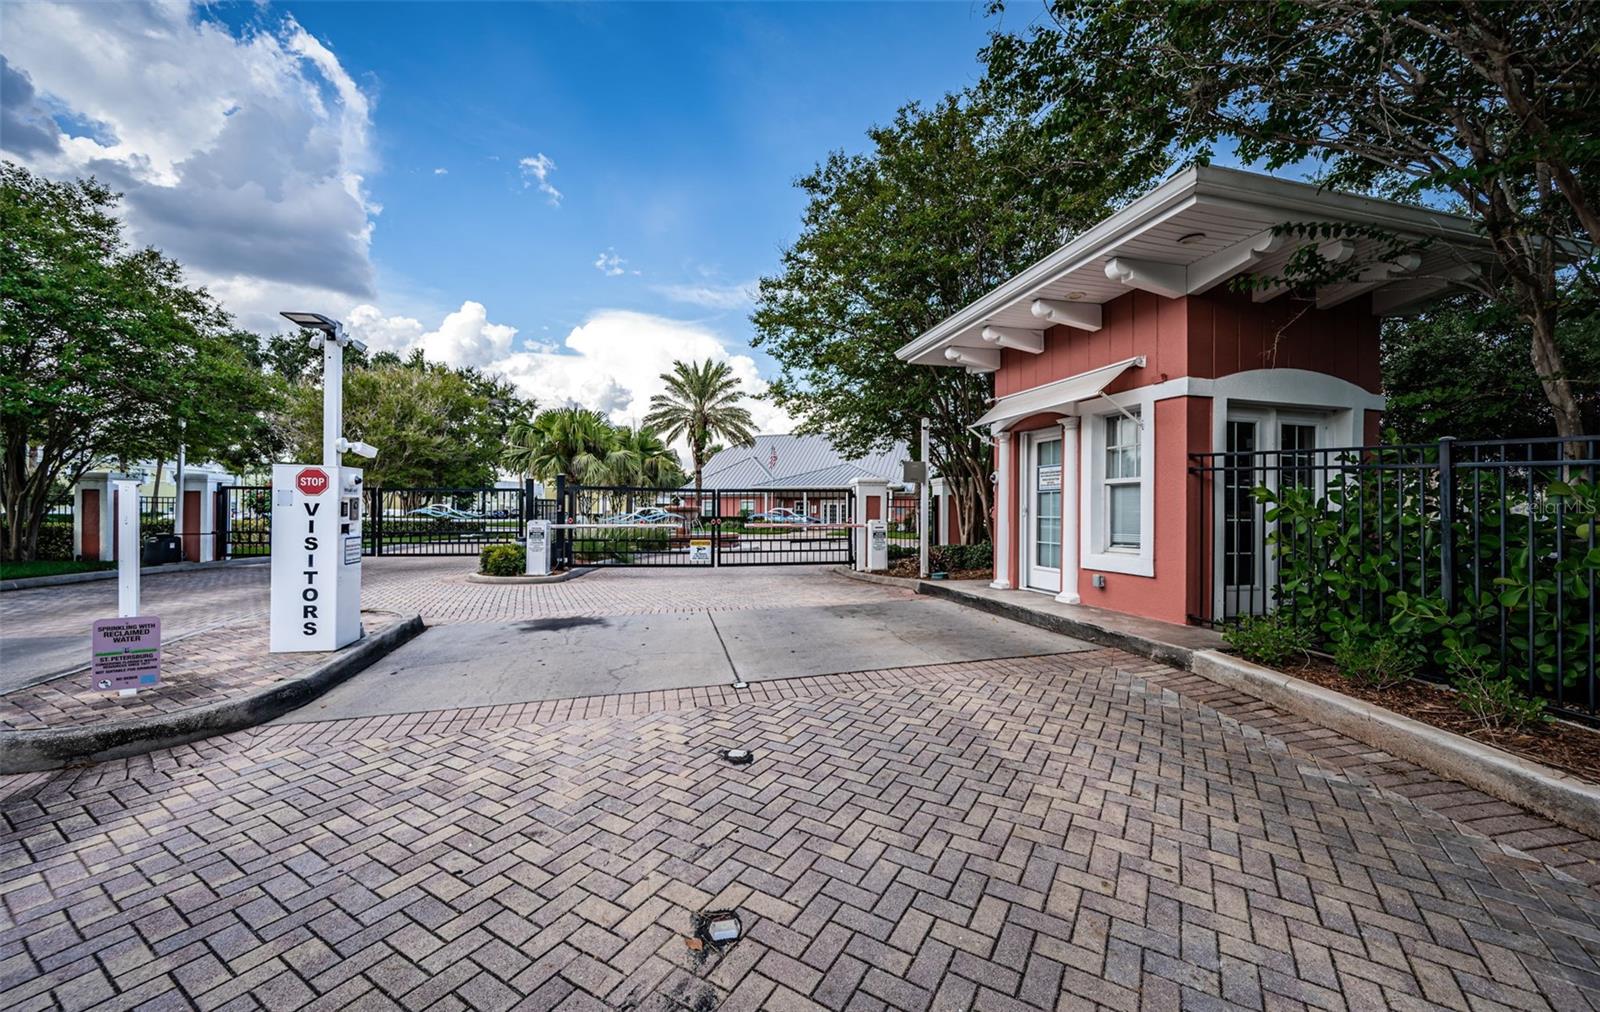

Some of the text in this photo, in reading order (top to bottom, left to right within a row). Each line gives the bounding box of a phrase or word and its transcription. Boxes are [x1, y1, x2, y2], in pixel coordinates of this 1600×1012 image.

[300, 477, 325, 487] STOP
[302, 503, 320, 636] VISITORS
[98, 624, 138, 632] SPRINKLING
[103, 629, 150, 638] RECLAIMED
[111, 653, 154, 661] PETERSBURG
